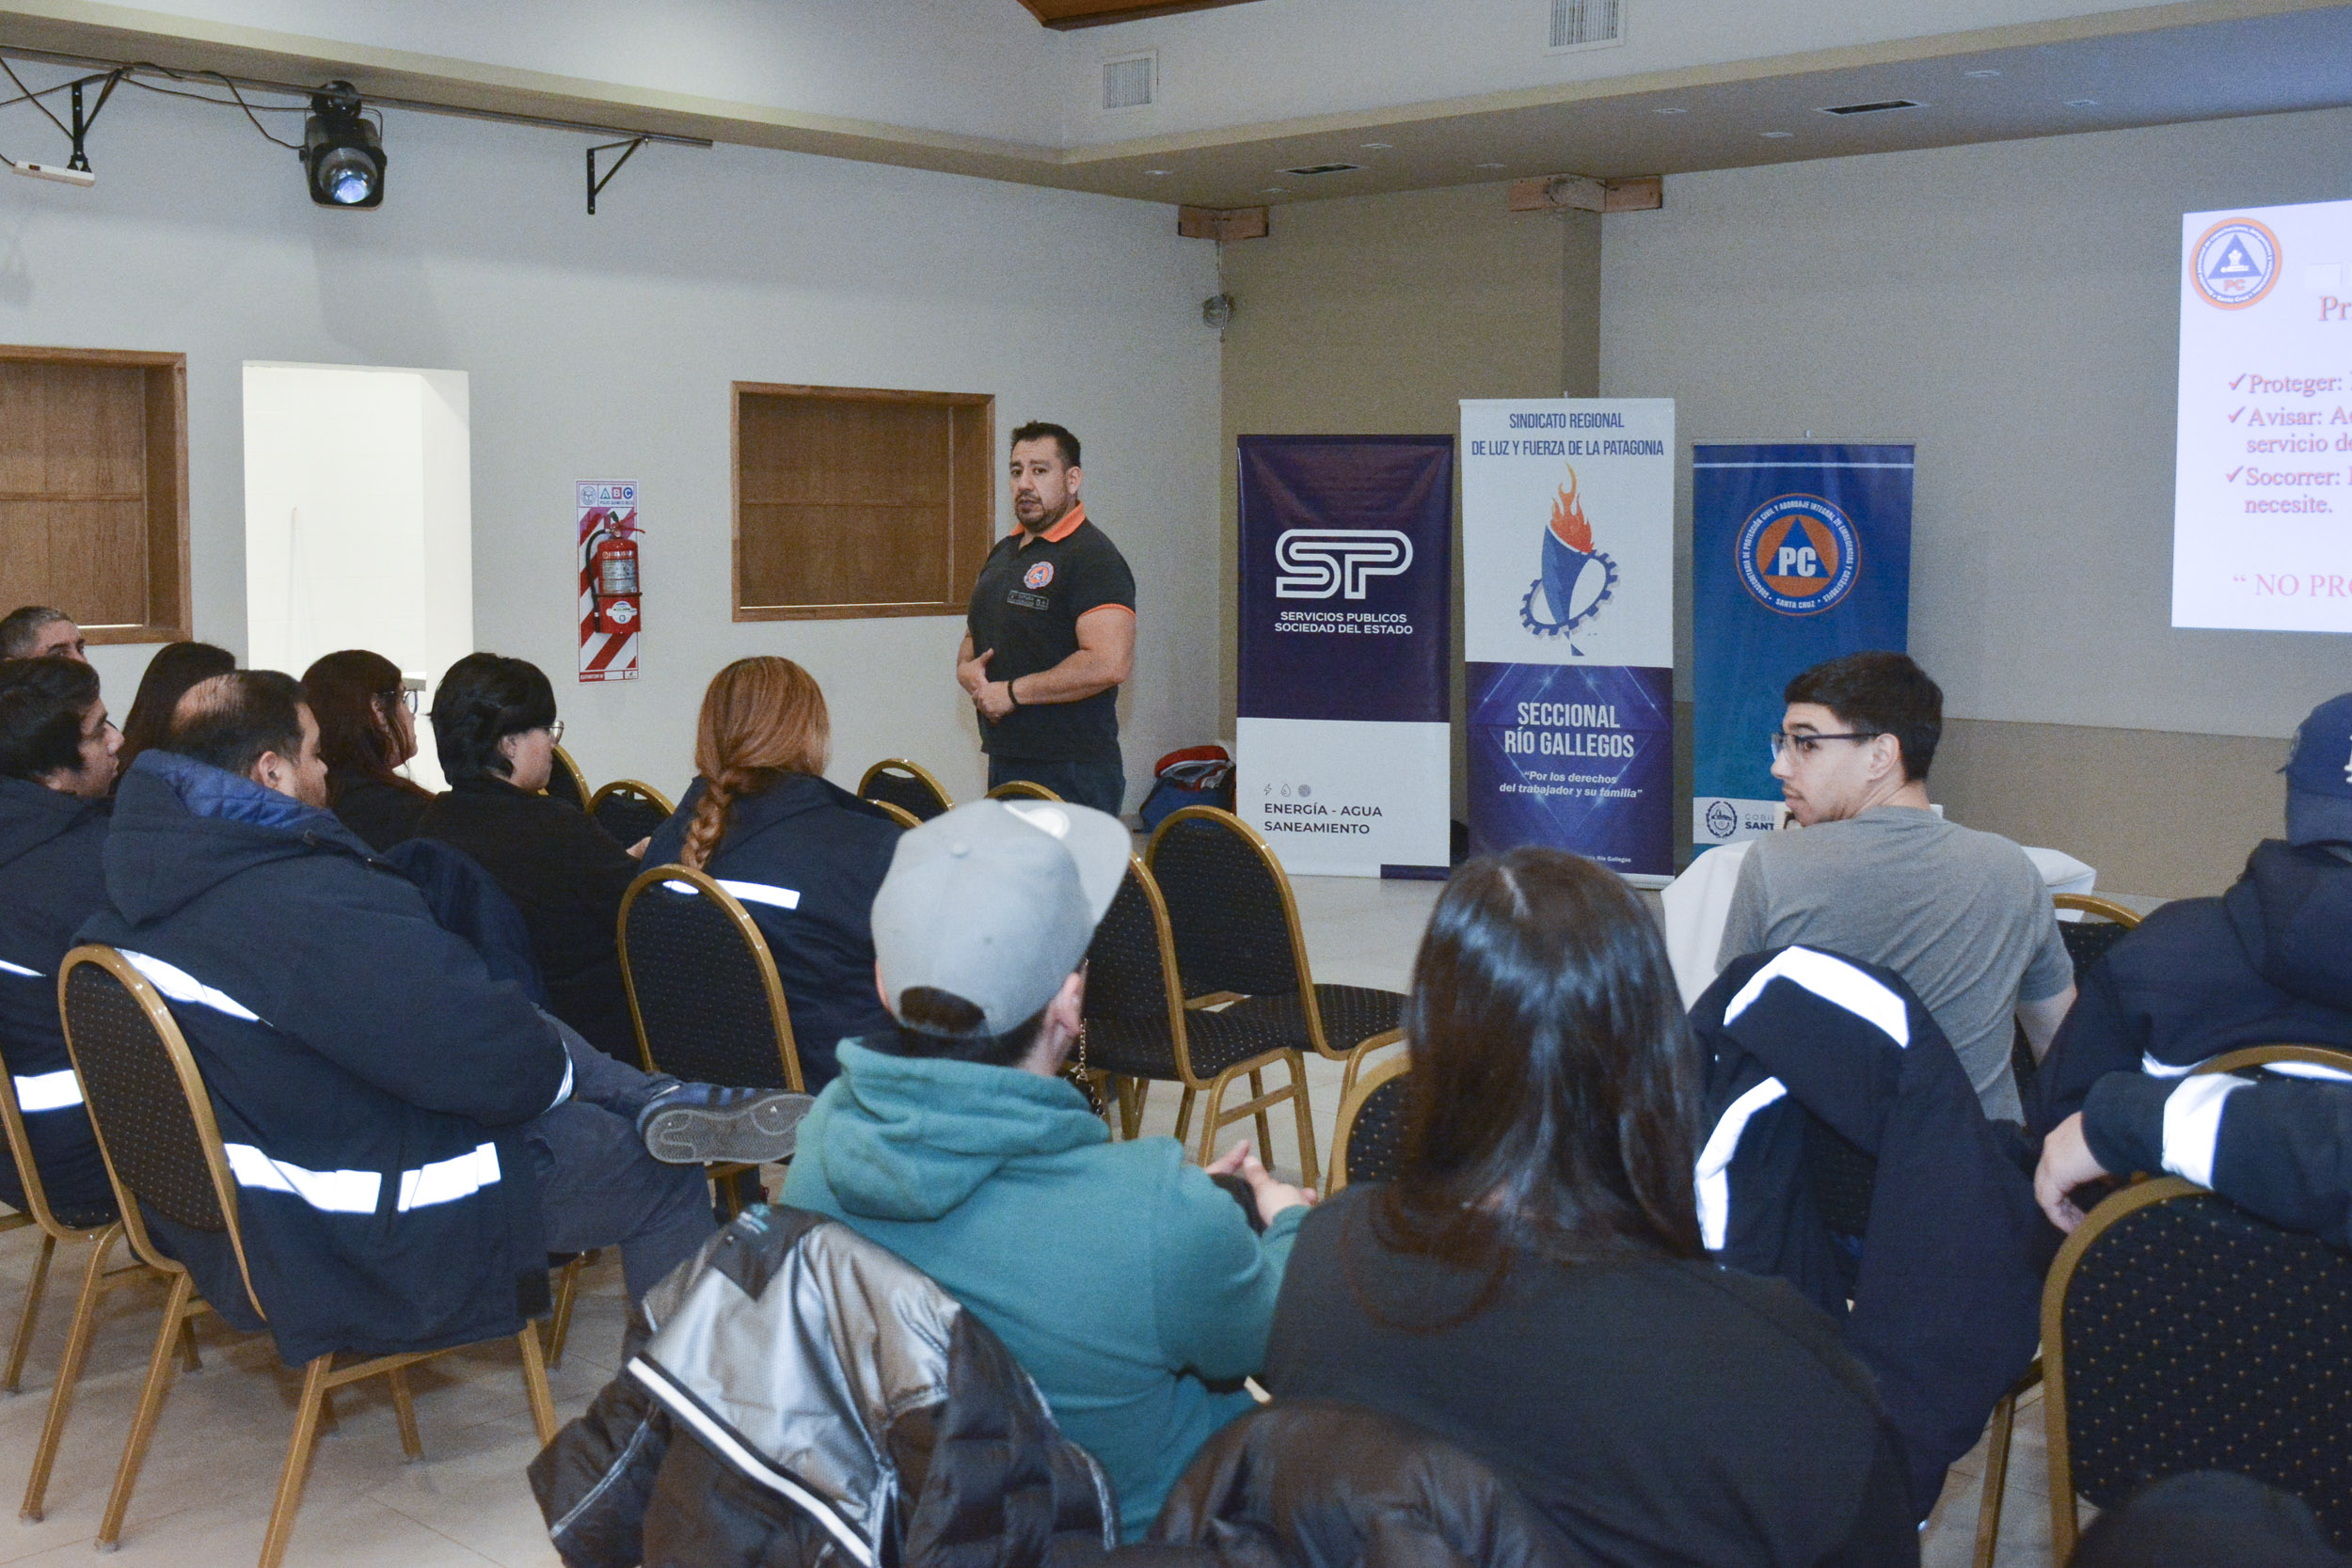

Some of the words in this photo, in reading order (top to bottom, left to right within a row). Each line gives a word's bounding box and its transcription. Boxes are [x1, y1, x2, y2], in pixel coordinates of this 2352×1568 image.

[2319, 296, 2352, 321] Pr
[2249, 374, 2342, 397] Proteger:
[1510, 413, 1566, 428] SINDICATO
[1570, 413, 1624, 428] REGIONAL
[2248, 406, 2322, 426] Avisar:
[1472, 441, 1486, 455] DE
[1489, 441, 1509, 455] LUZ
[1512, 441, 1520, 455] Y
[1523, 441, 1565, 455] FUERZA
[1569, 441, 1582, 455] DE
[1586, 440, 1600, 455] LA
[1603, 440, 1664, 455] PATAGONIA
[2246, 433, 2328, 453] servicio
[2246, 467, 2340, 486] Socorrer:
[2245, 493, 2333, 513] necesite.
[1760, 508, 1775, 520] CIVIL
[1810, 503, 1835, 521] INTEGRAL
[1833, 518, 1843, 527] DE
[1275, 529, 1413, 599] SP
[1778, 547, 1816, 577] PC
[2256, 574, 2299, 596] NO
[2309, 575, 2352, 597] PR
[1776, 598, 1796, 608] SANTA
[1798, 600, 1815, 609] CRUZ
[1280, 612, 1344, 622] SERVICIOS
[1347, 613, 1407, 623] PUBLICOS
[1275, 623, 1335, 633] SOCIEDAD
[1338, 624, 1361, 633] DEL
[1364, 625, 1413, 634] ESTADO
[1518, 702, 1620, 728] SECCIONAL
[1505, 726, 1535, 753] RÍO
[1540, 732, 1635, 758] GALLEGOS
[1524, 771, 1547, 780] “Por
[1550, 772, 1565, 781] los
[1568, 773, 1617, 784] derechos
[1499, 783, 1516, 792] del
[1518, 784, 1573, 796] trabajador
[1600, 787, 1643, 798] familia”
[1264, 802, 1327, 815] ENERGÍA
[1340, 806, 1382, 817] AGUA
[1264, 821, 1370, 834] SANEAMIENTO
[1745, 822, 1774, 830] SANT
